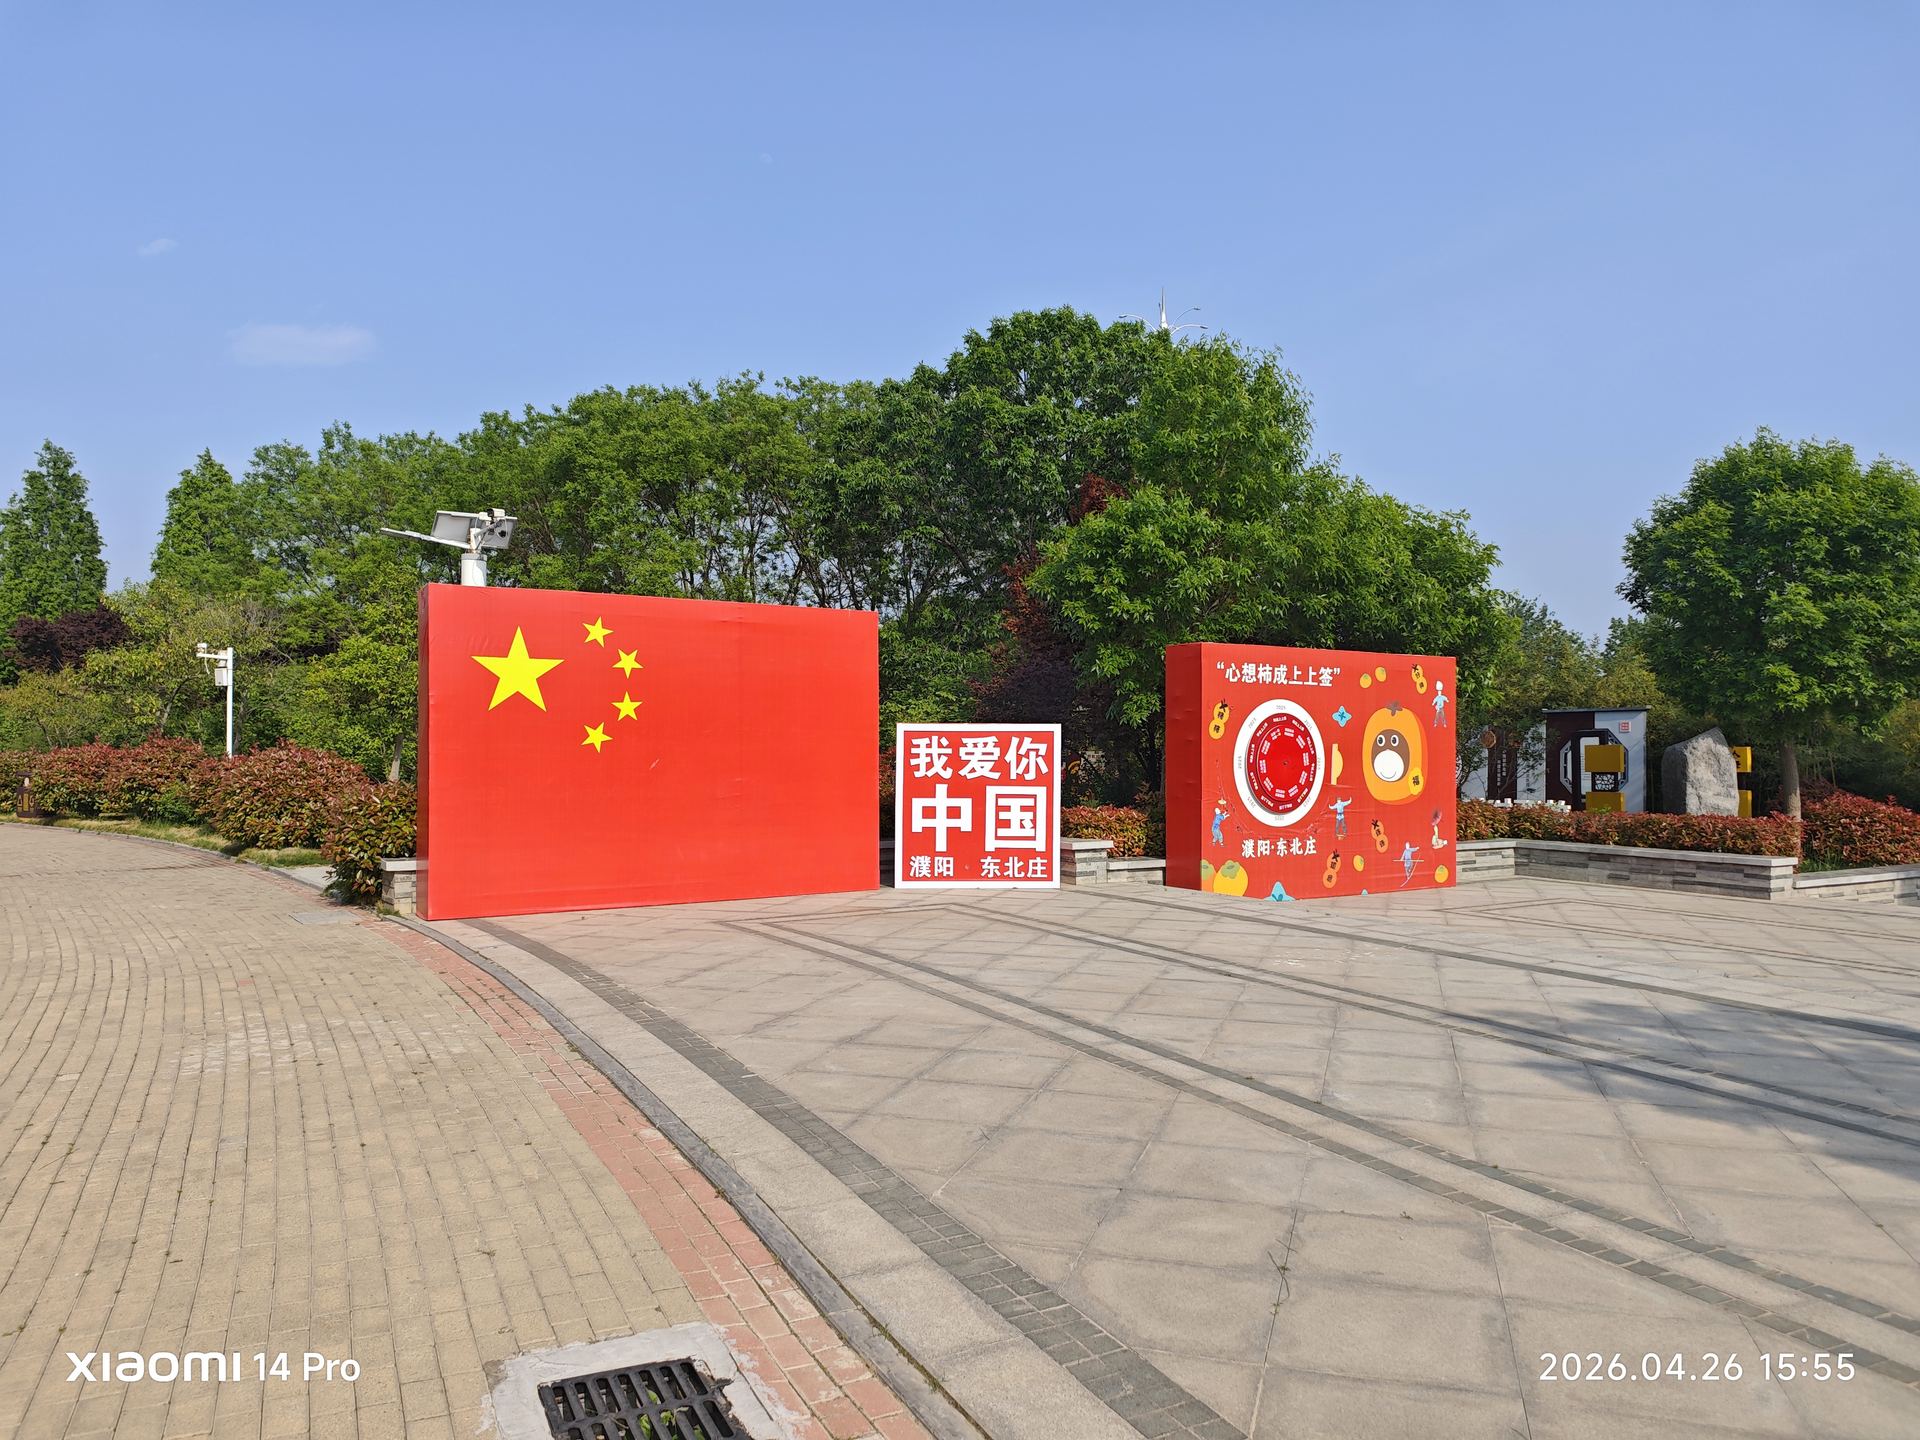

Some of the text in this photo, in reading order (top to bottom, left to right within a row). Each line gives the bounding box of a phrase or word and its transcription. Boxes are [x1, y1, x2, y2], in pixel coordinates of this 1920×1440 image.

[1216, 661, 1341, 687] “心想柿成上上签”
[909, 735, 1049, 781] 我爱你
[911, 783, 1047, 852] 中国
[909, 855, 1048, 878] 濮阳 东北庄
